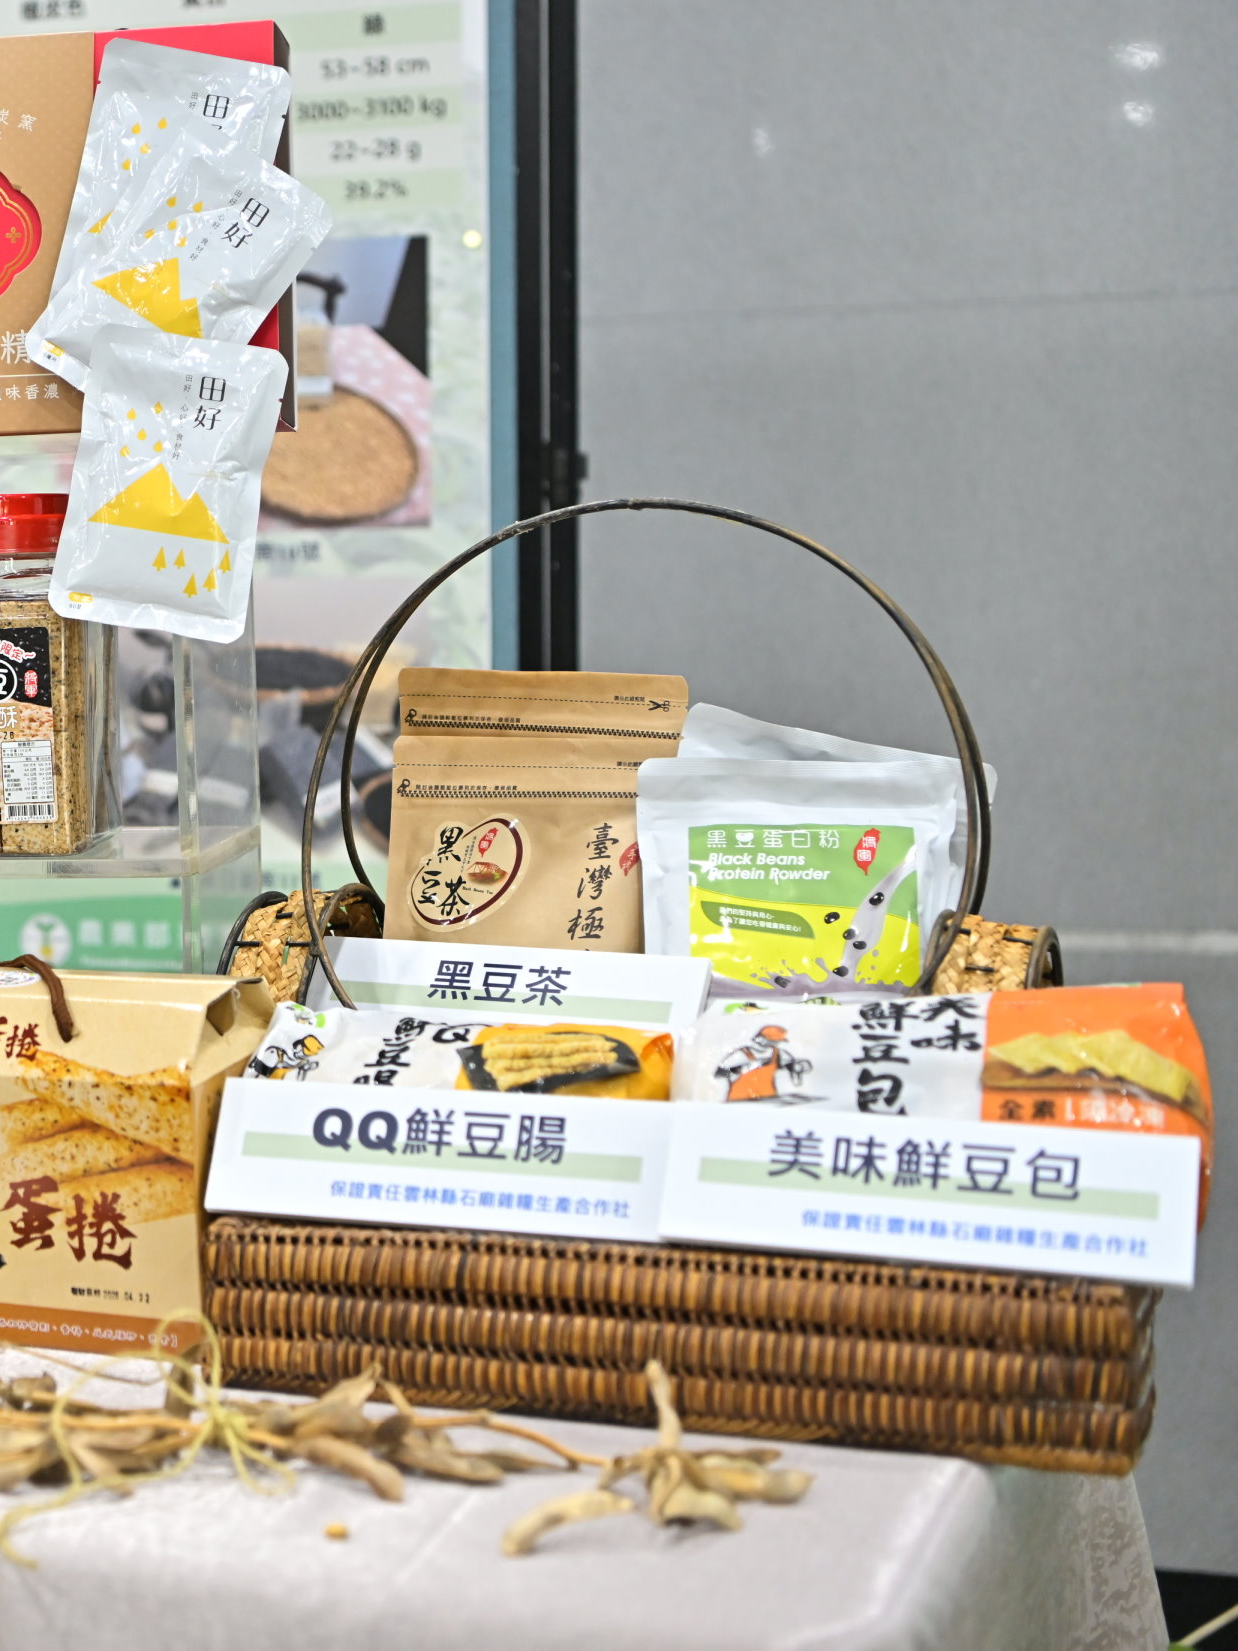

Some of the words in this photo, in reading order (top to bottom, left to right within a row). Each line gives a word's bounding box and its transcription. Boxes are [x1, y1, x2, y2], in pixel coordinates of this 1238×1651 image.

[221, 197, 270, 248] 田好
[193, 376, 227, 431] 田好
[707, 829, 840, 849] 黑豆蛋白粉
[708, 852, 752, 866] Black
[756, 852, 805, 866] Beans
[418, 826, 470, 917] 黑豆茶
[567, 822, 619, 951] 臺灣極
[708, 867, 765, 881] Protein
[426, 959, 572, 1007] 黑豆茶
[851, 1001, 920, 1116] 鮮豆包
[312, 1106, 567, 1165] QQ鮮豆腸
[767, 1129, 1082, 1202] 美味鮮豆包
